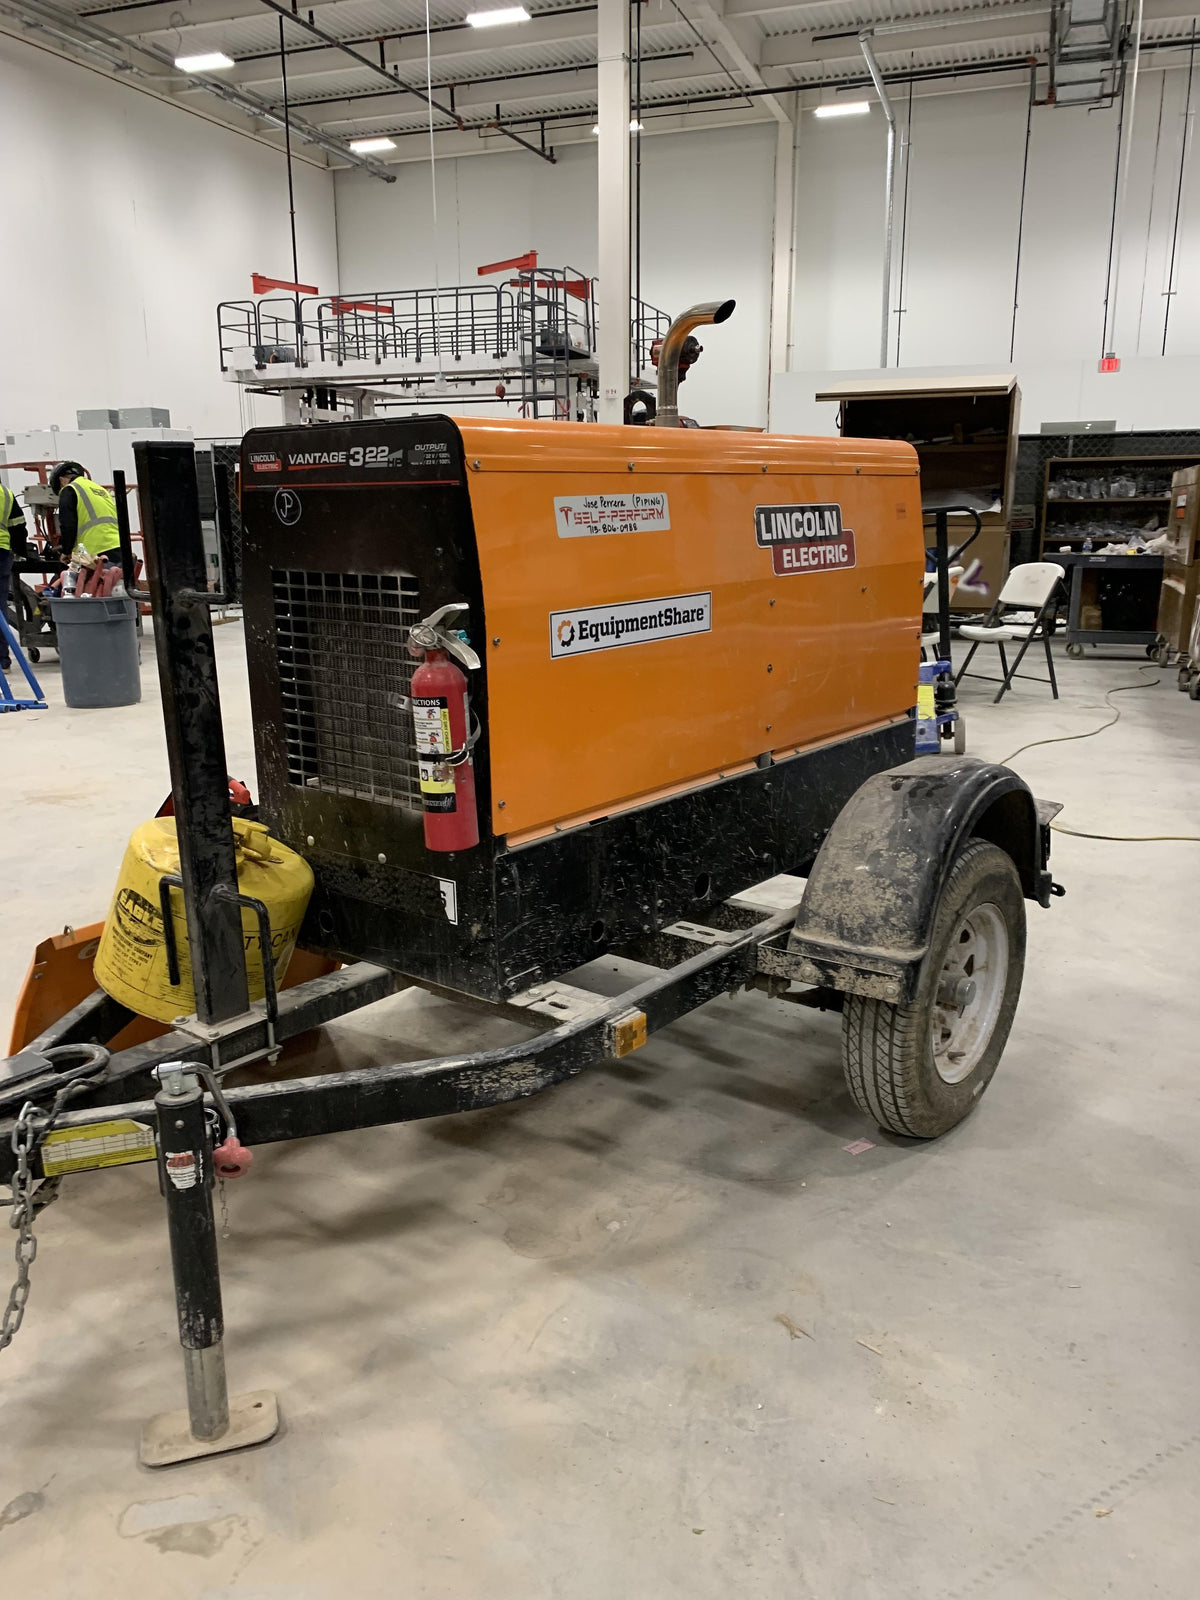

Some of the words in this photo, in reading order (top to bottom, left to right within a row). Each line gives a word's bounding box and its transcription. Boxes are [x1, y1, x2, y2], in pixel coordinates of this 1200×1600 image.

[288, 451, 347, 465] VANTAGE
[349, 446, 390, 467] 322
[414, 443, 445, 452] OUTPUT
[250, 454, 275, 463] LINCOLN
[583, 497, 599, 509] Jose
[632, 493, 665, 510] (PIPING)
[573, 508, 665, 526] SELF-PERFORM
[760, 510, 838, 541] LINCOLN
[782, 543, 849, 569] ELECTRIC
[578, 606, 705, 642] EquipmentShare
